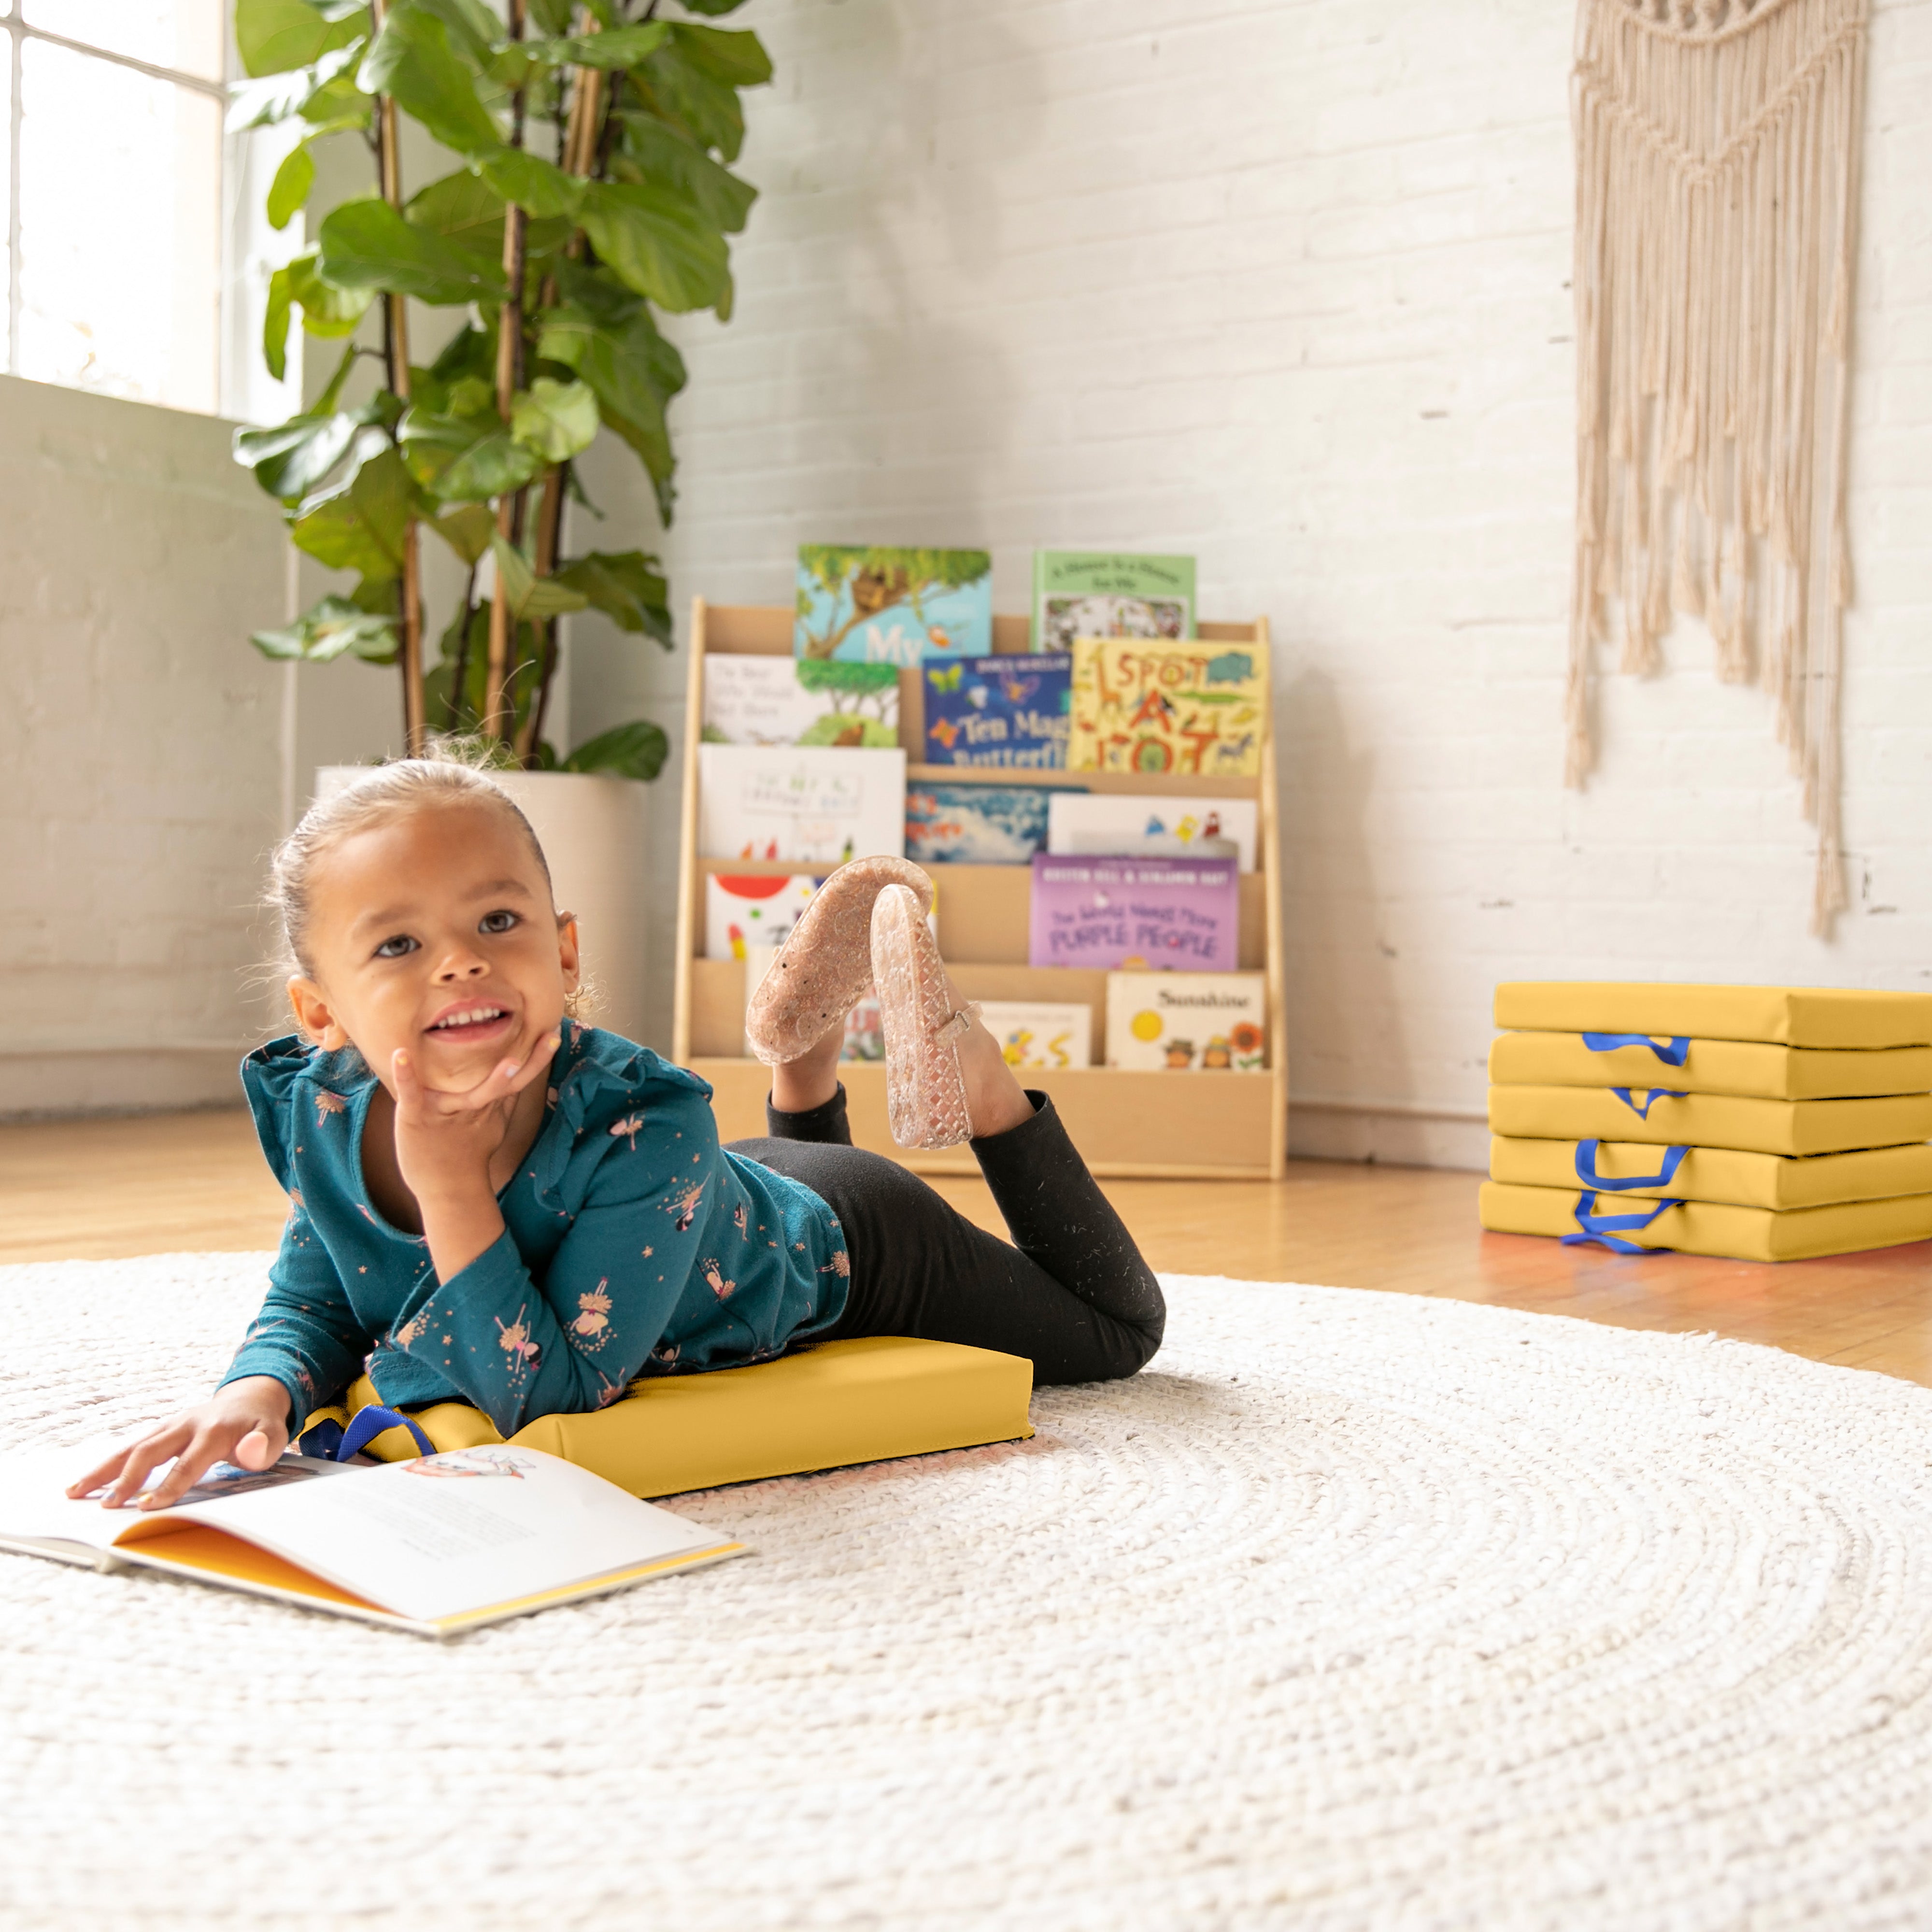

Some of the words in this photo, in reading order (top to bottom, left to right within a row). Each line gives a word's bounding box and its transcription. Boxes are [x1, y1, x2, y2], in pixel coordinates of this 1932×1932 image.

[866, 625, 923, 667] My
[1117, 653, 1209, 688] SPOT
[957, 713, 1008, 743] Ten
[1128, 690, 1171, 733] A
[1079, 905, 1124, 919] World
[1130, 904, 1175, 922] Needs
[1181, 908, 1217, 929] More
[1049, 923, 1126, 953] PURPLE
[1136, 924, 1217, 958] PEOPLE
[1159, 989, 1250, 1008] Sunshine
